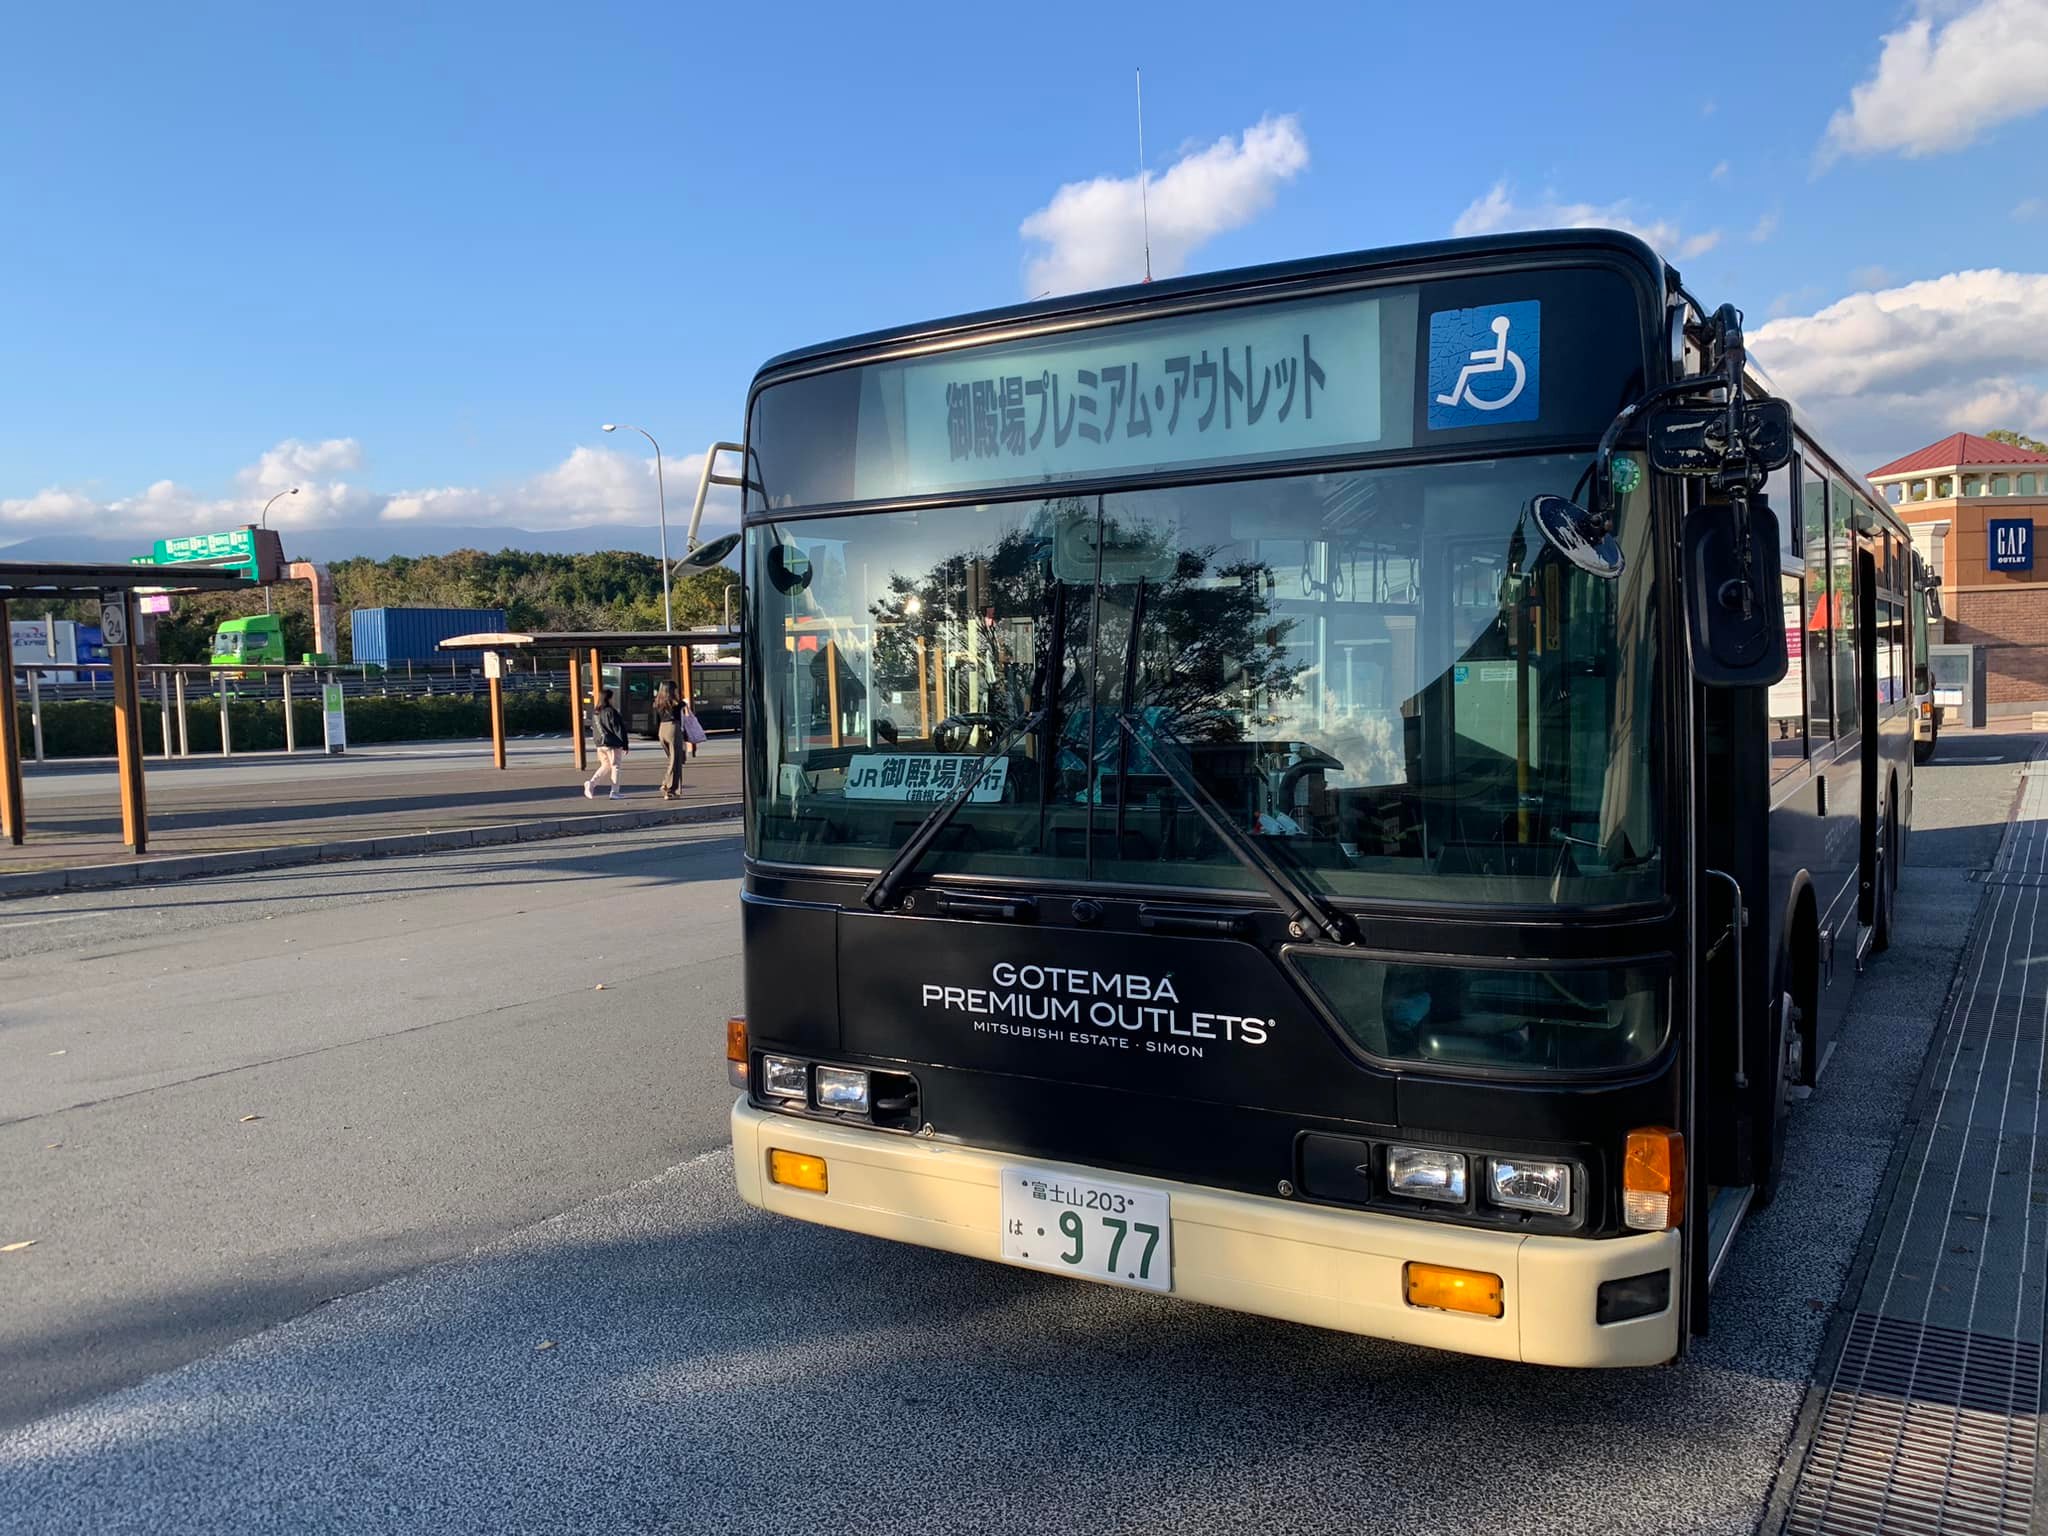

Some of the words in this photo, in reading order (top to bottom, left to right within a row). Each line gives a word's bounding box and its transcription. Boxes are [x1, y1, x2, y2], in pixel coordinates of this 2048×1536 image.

[945, 334, 1326, 462] 御殿場プレミアム・アウトレット
[1997, 527, 2026, 555] GAP
[1997, 556, 2026, 564] OUTLET
[108, 620, 121, 637] 24
[992, 961, 1179, 1004] GOTEMBA
[922, 984, 1080, 1024] PREMIUM
[973, 1020, 1064, 1041] MITSUBISHI
[1069, 1032, 1130, 1050] ESTATE
[1145, 1040, 1204, 1058] SIMON
[1008, 1218, 1024, 1237] は
